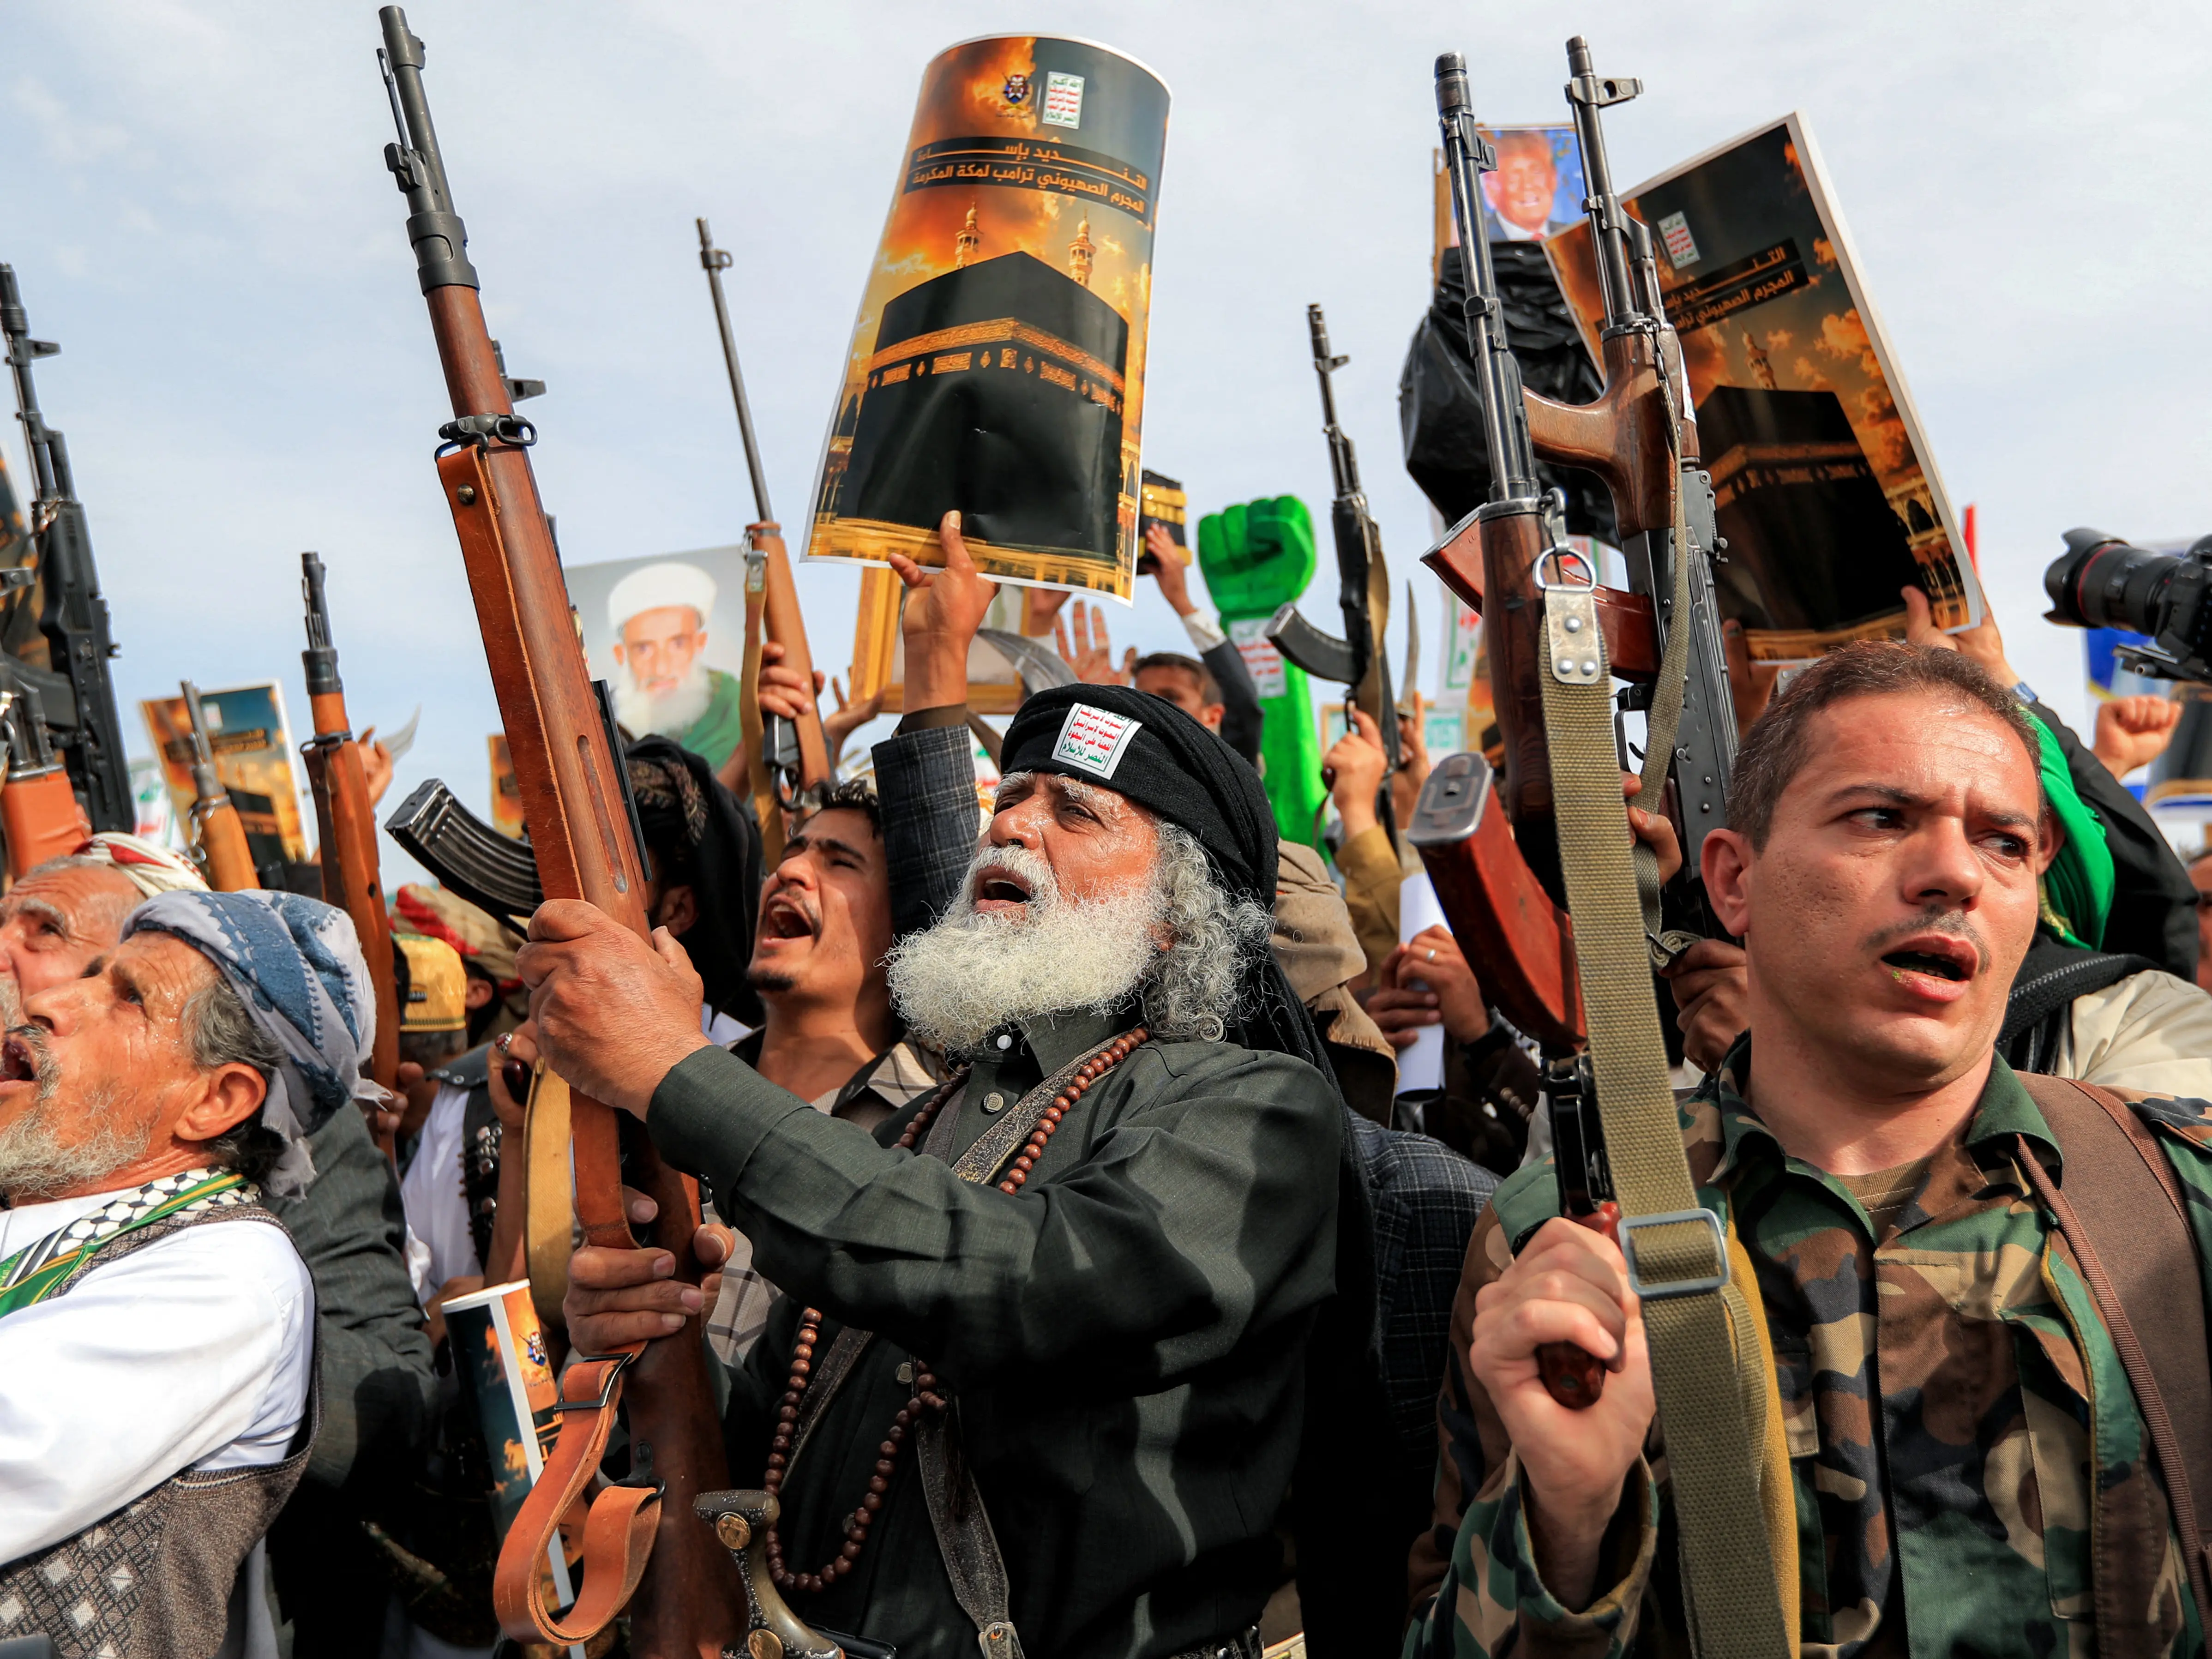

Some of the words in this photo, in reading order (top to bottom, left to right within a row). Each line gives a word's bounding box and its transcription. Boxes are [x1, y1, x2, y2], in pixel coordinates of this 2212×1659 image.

[913, 165, 954, 184] المكرمة
[956, 164, 990, 178] لمكة
[992, 167, 1035, 184] ترامب
[1037, 173, 1108, 197] الصهيوني
[1110, 192, 1145, 214] المجرم
[1755, 270, 1794, 301] المجرم
[1105, 719, 1125, 730] الموت
[1068, 730, 1086, 742] اليهود
[1099, 729, 1119, 740] الموت
[1084, 752, 1109, 765] النصر
